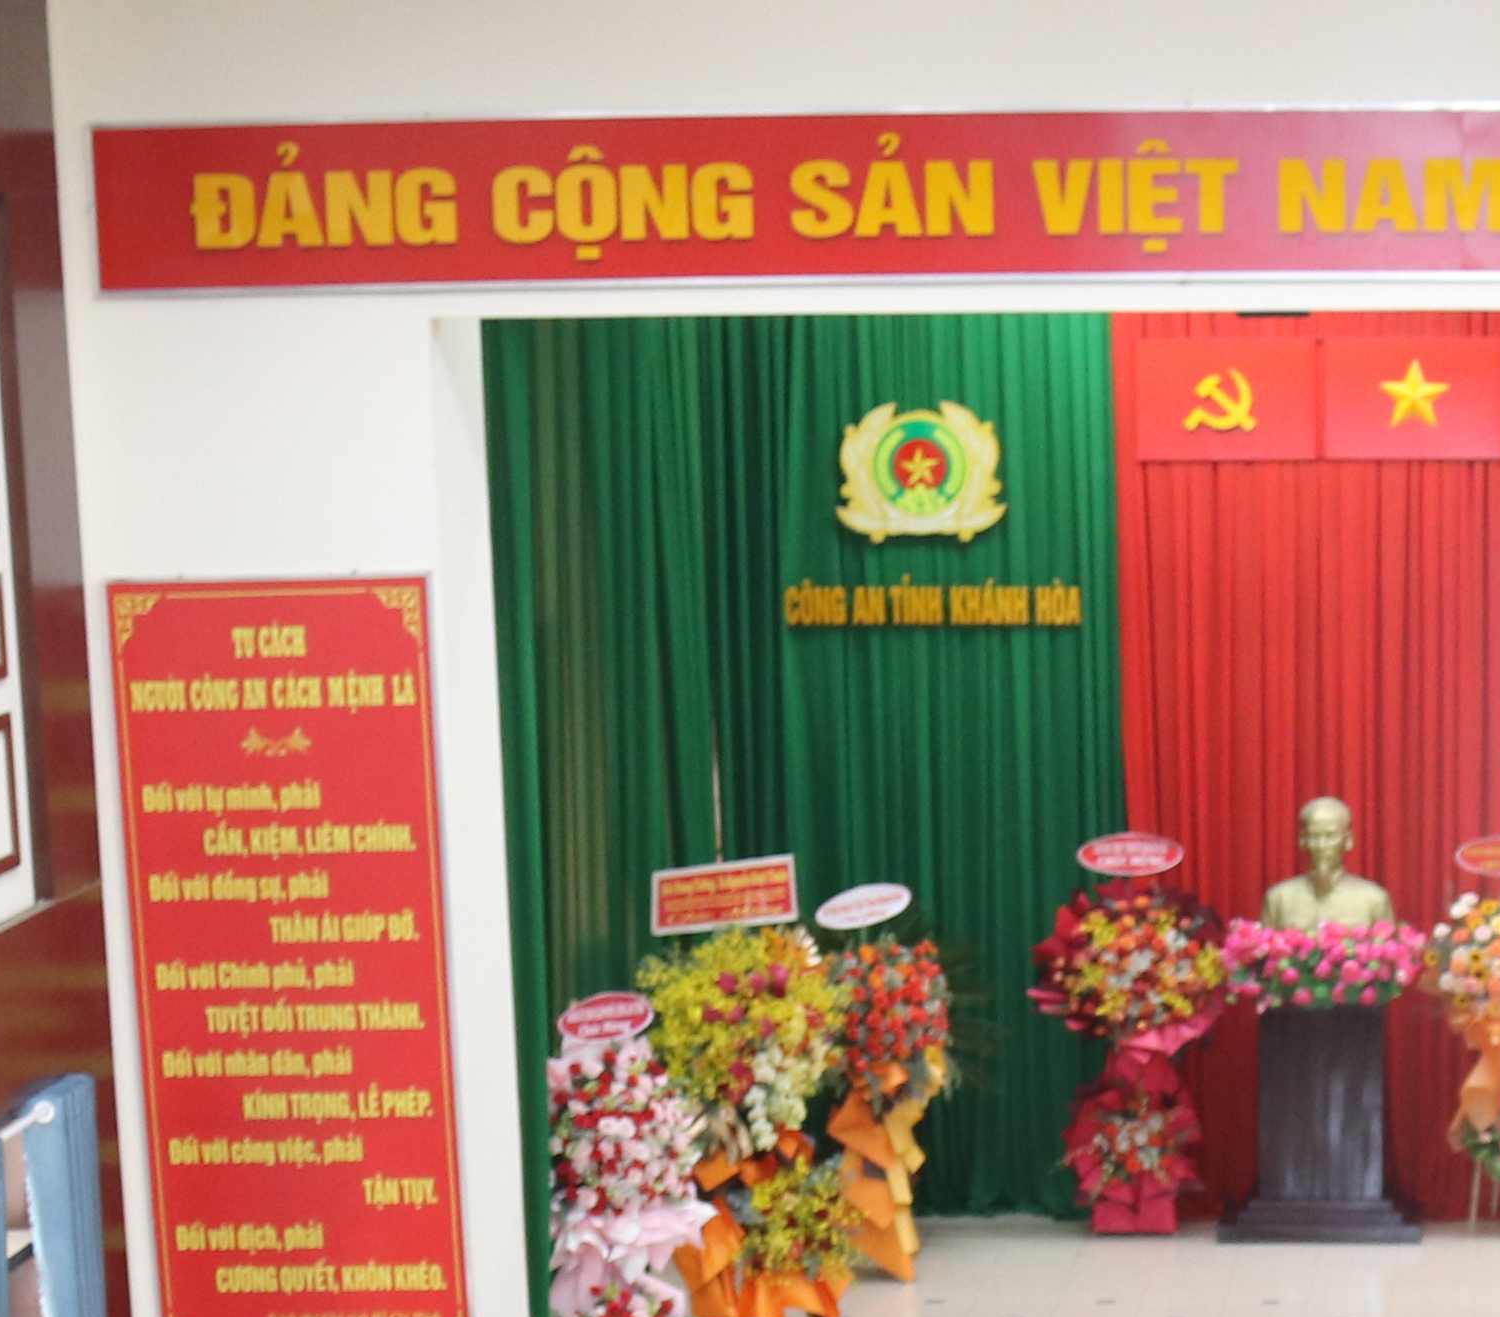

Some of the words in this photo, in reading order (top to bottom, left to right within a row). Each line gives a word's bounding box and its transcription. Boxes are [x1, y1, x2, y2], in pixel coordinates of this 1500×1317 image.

[190, 142, 457, 250] ĐẢNG
[492, 147, 755, 260] CỘNG
[790, 133, 994, 239] SẢN
[1032, 140, 1238, 253] VIỆT
[784, 577, 848, 626] CÔNG
[852, 586, 886, 626] AN
[889, 573, 944, 626] TỈNH
[950, 578, 1030, 626] KHÁNH
[1035, 578, 1082, 626] HÒA
[231, 626, 255, 658] TƯ
[259, 620, 306, 658] CÁCH
